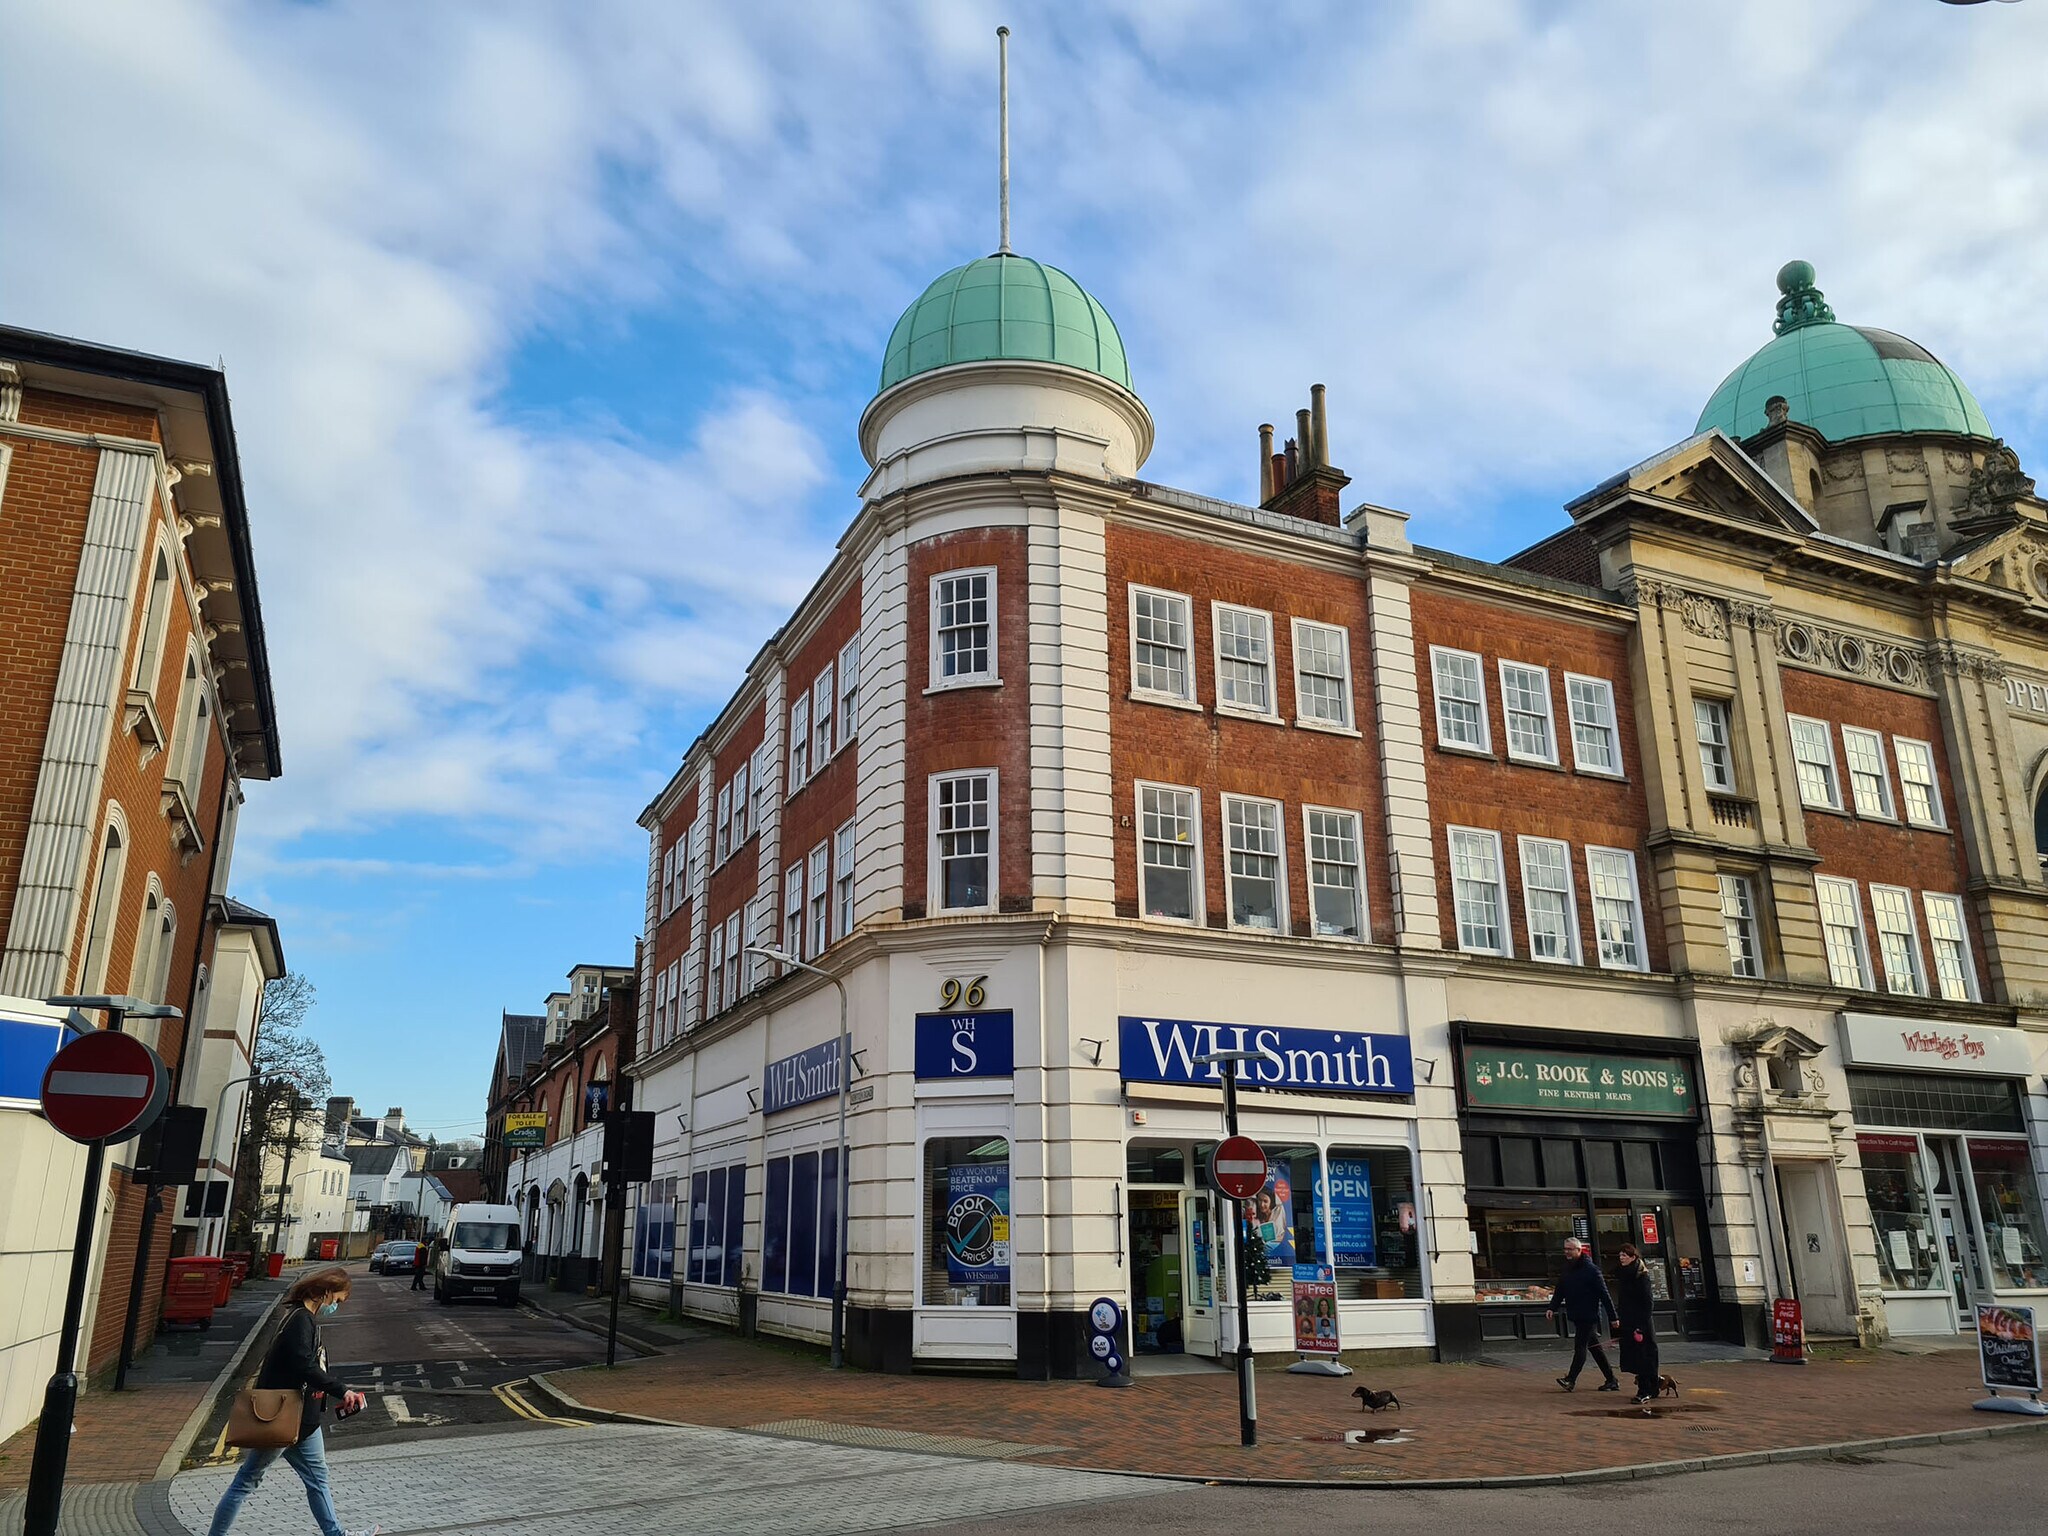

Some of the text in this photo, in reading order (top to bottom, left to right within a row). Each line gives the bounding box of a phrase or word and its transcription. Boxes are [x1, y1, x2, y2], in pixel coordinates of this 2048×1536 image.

[938, 975, 988, 1010] 96
[951, 1018, 976, 1030] WH
[951, 1030, 977, 1073] S
[1959, 1033, 1986, 1059] Toys
[1142, 1020, 1395, 1088] WHSmith
[770, 1041, 842, 1109] WHSmith
[1496, 1061, 1668, 1088] J.C. ROOK & SONS
[1538, 1088, 1632, 1101] FINE KENTISH MEATS
[950, 1166, 1008, 1176] WE WON'T BE
[950, 1175, 998, 1184] BEATEN ON
[950, 1184, 975, 1192] PRICE
[1314, 1179, 1369, 1198] OPEN
[947, 1197, 986, 1228] BOOK
[961, 1251, 988, 1262] PRICE
[964, 1271, 999, 1280] WHSmith
[1308, 1283, 1334, 1295] Free
[1297, 1339, 1337, 1348] Face Masks
